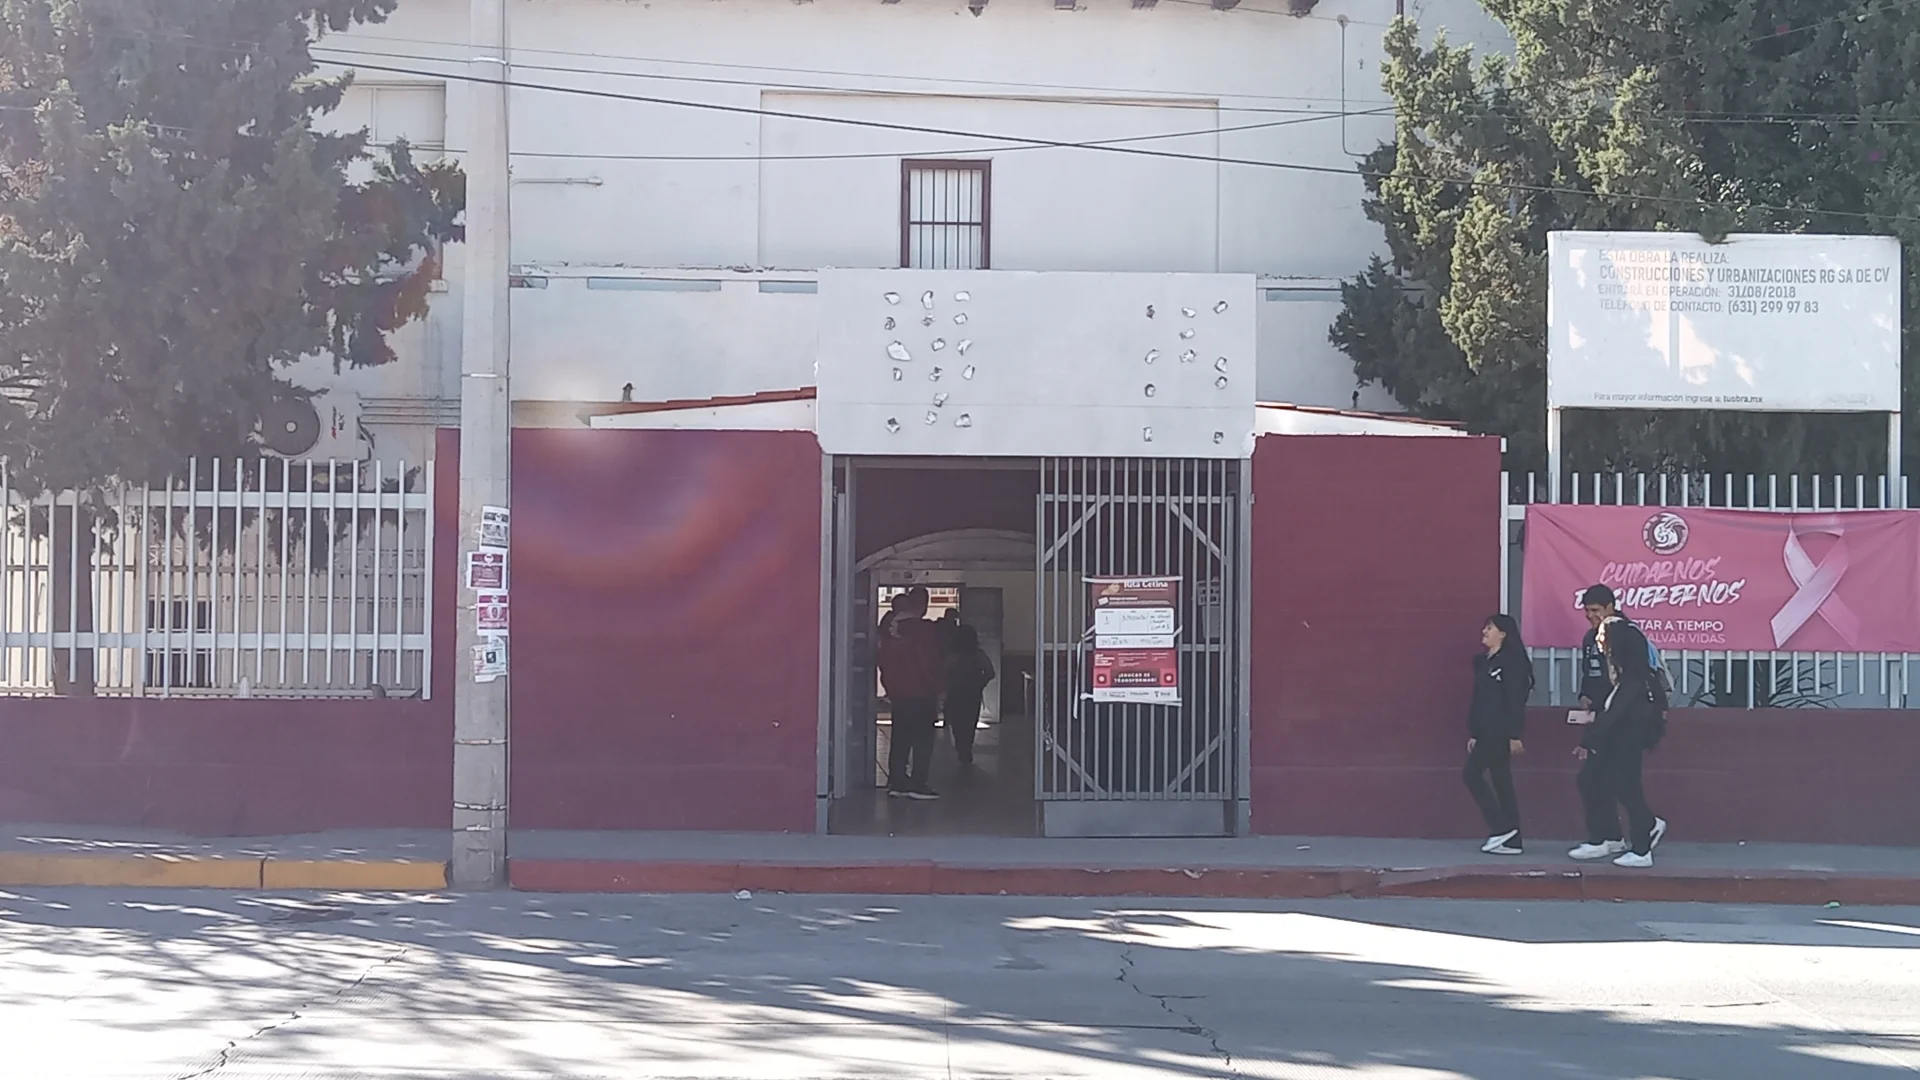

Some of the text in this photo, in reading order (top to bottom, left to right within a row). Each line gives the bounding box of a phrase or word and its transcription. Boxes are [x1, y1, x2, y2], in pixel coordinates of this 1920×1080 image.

[1599, 249, 1729, 264] ESTA OBRA LA REALIZA:
[1600, 265, 1890, 283] CONSTRUCCIONES Y URBANIZACIONES RG SA DE CV
[1646, 286, 1659, 297] EN
[1662, 285, 1721, 297] OPERACIÓN:
[1728, 286, 1796, 298] 31/08/2018
[1654, 300, 1667, 311] DE
[1670, 301, 1723, 312] CONTACTO:
[1728, 300, 1757, 315] (631)
[1760, 301, 1783, 313] 299
[1787, 301, 1801, 313] 97
[1804, 301, 1819, 313] 83
[1594, 392, 1610, 401] Para
[1612, 393, 1635, 403] mayor
[1638, 392, 1684, 402] información
[1685, 394, 1713, 404] ingrese
[1599, 556, 1721, 584] CUIDARNOS
[1614, 579, 1746, 611] QUERERNOS
[1664, 619, 1674, 631] A
[1676, 620, 1724, 632] TIEMPO
[1688, 633, 1726, 644] VIDAS
